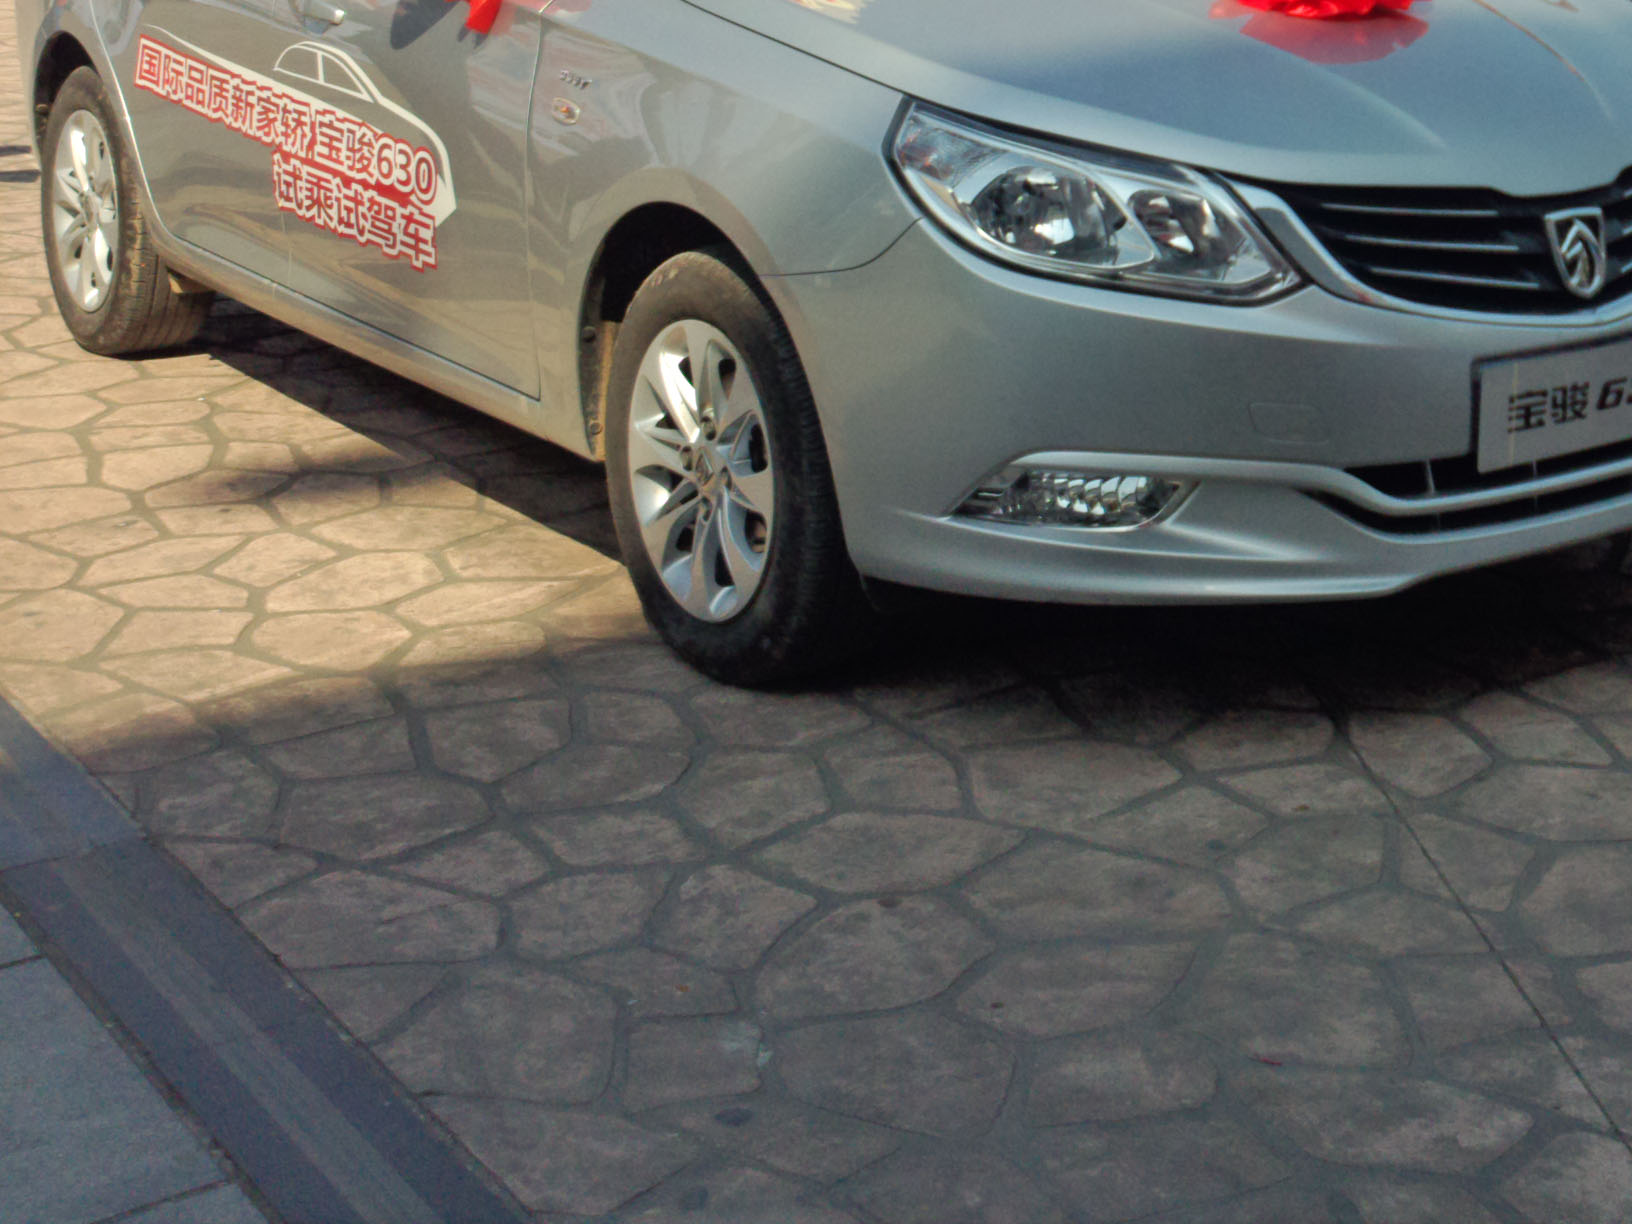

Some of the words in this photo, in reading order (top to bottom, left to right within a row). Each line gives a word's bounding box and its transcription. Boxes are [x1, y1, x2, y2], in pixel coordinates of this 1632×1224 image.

[273, 152, 437, 269] 试乘试驾车
